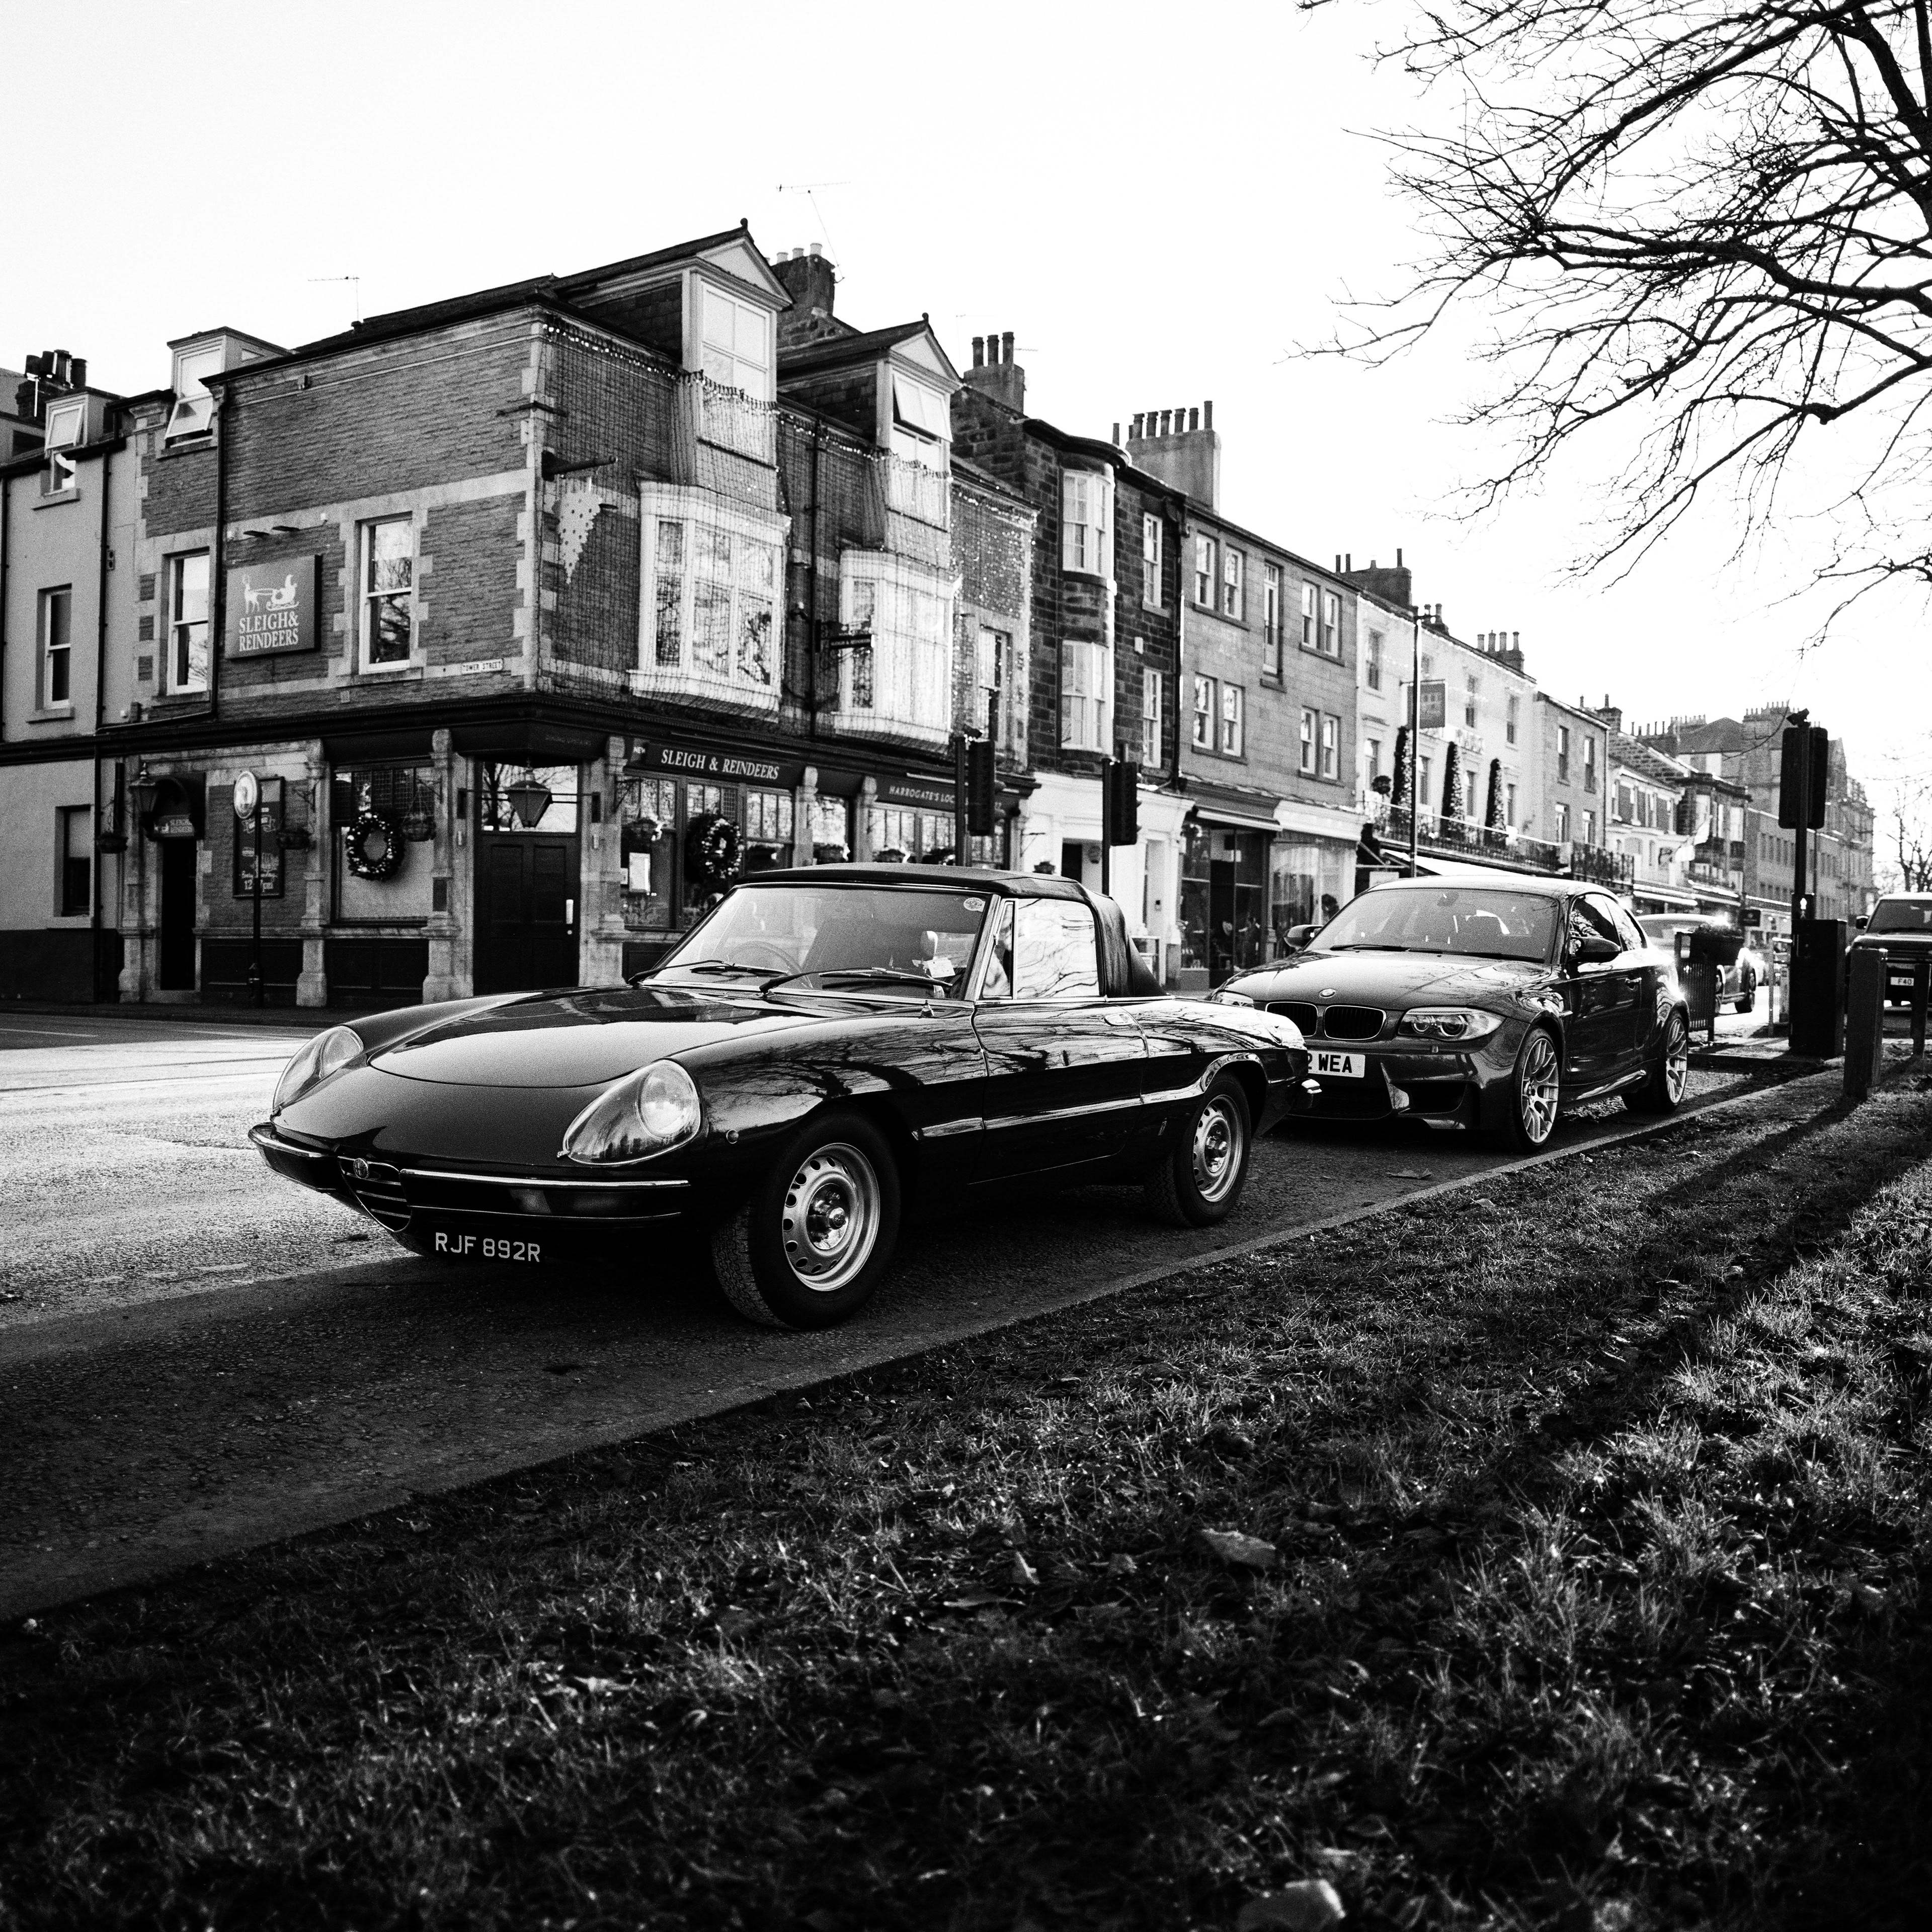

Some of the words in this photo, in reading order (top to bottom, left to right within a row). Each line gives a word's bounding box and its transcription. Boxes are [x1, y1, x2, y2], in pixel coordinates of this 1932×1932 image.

[239, 611, 299, 633] SLEIGH&
[239, 628, 298, 652] REINDEERS
[463, 663, 479, 671] TOWER
[482, 661, 501, 670] STREET
[661, 749, 705, 769] SLEIGH
[709, 757, 718, 771] &
[722, 759, 779, 779] REINDEERS
[889, 785, 940, 801] HARROGATE'S
[940, 793, 955, 804] LOC
[1318, 1054, 1352, 1073] WEA
[436, 1232, 476, 1254] RJF
[483, 1238, 540, 1262] 892R
